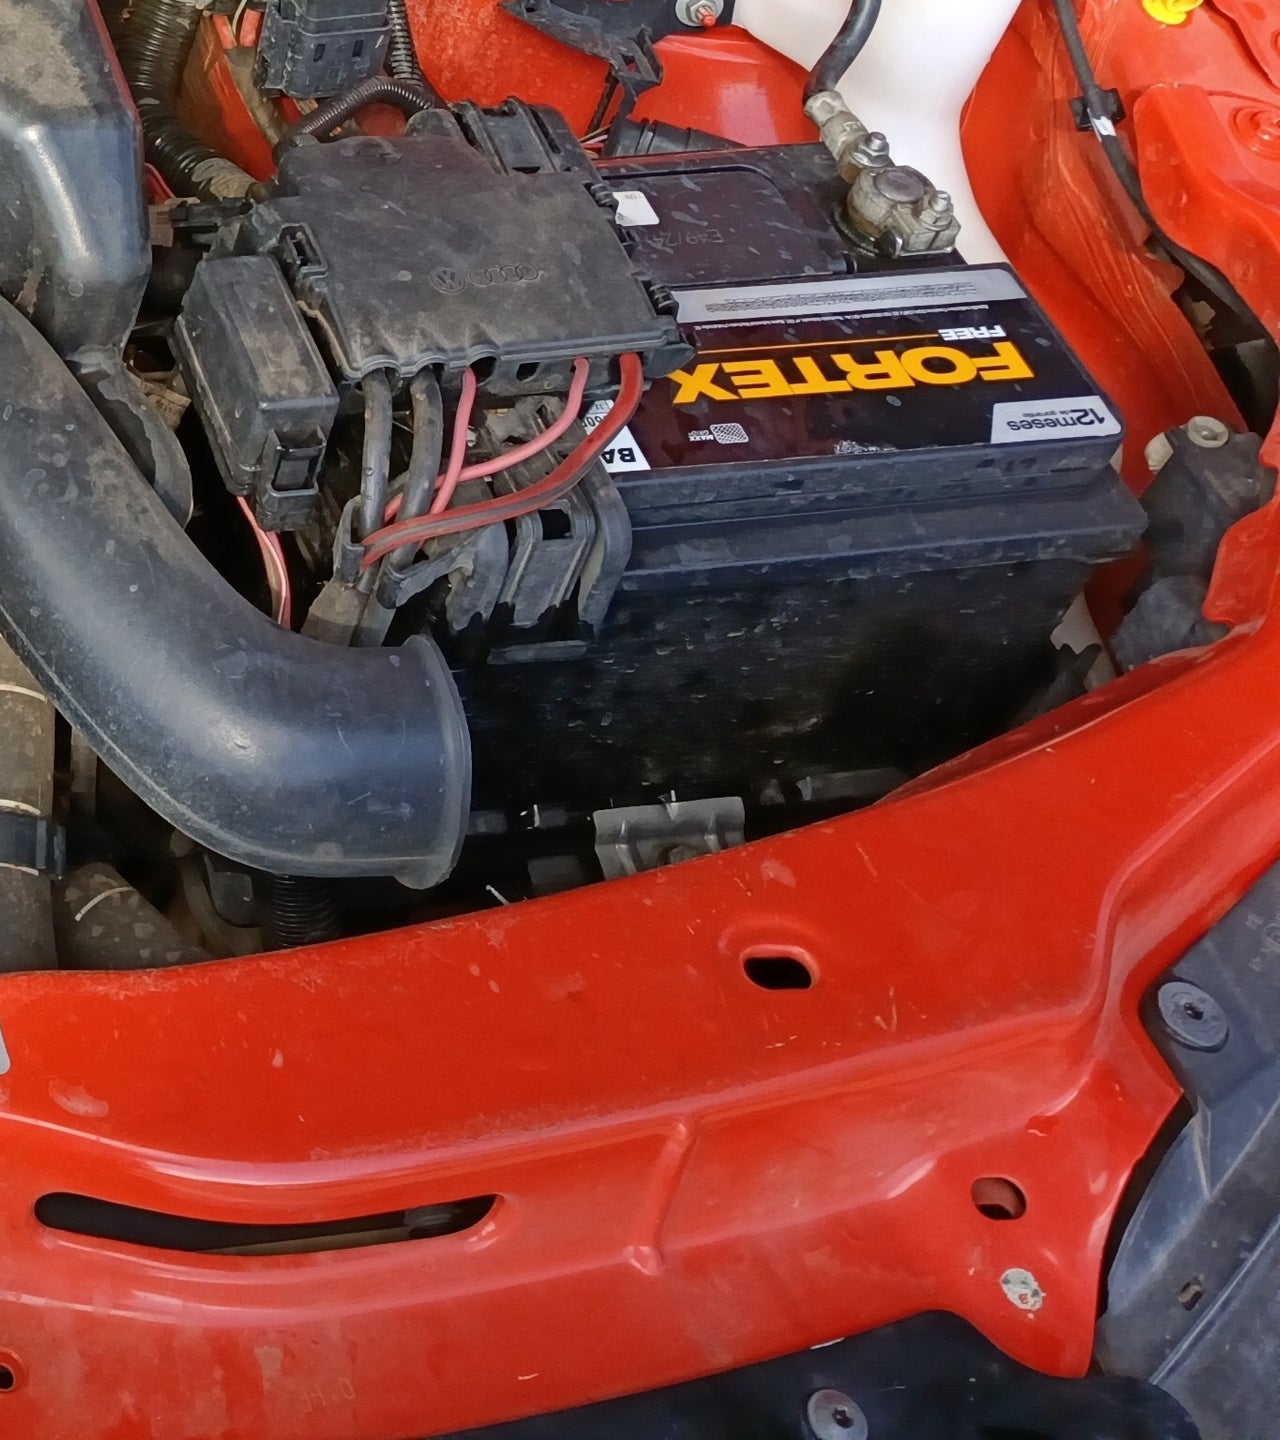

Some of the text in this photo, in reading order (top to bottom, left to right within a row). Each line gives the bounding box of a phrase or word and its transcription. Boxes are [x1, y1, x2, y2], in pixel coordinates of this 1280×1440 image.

[937, 324, 1006, 340] FREE
[669, 341, 1035, 405] FORTEX
[600, 447, 636, 464] BA
